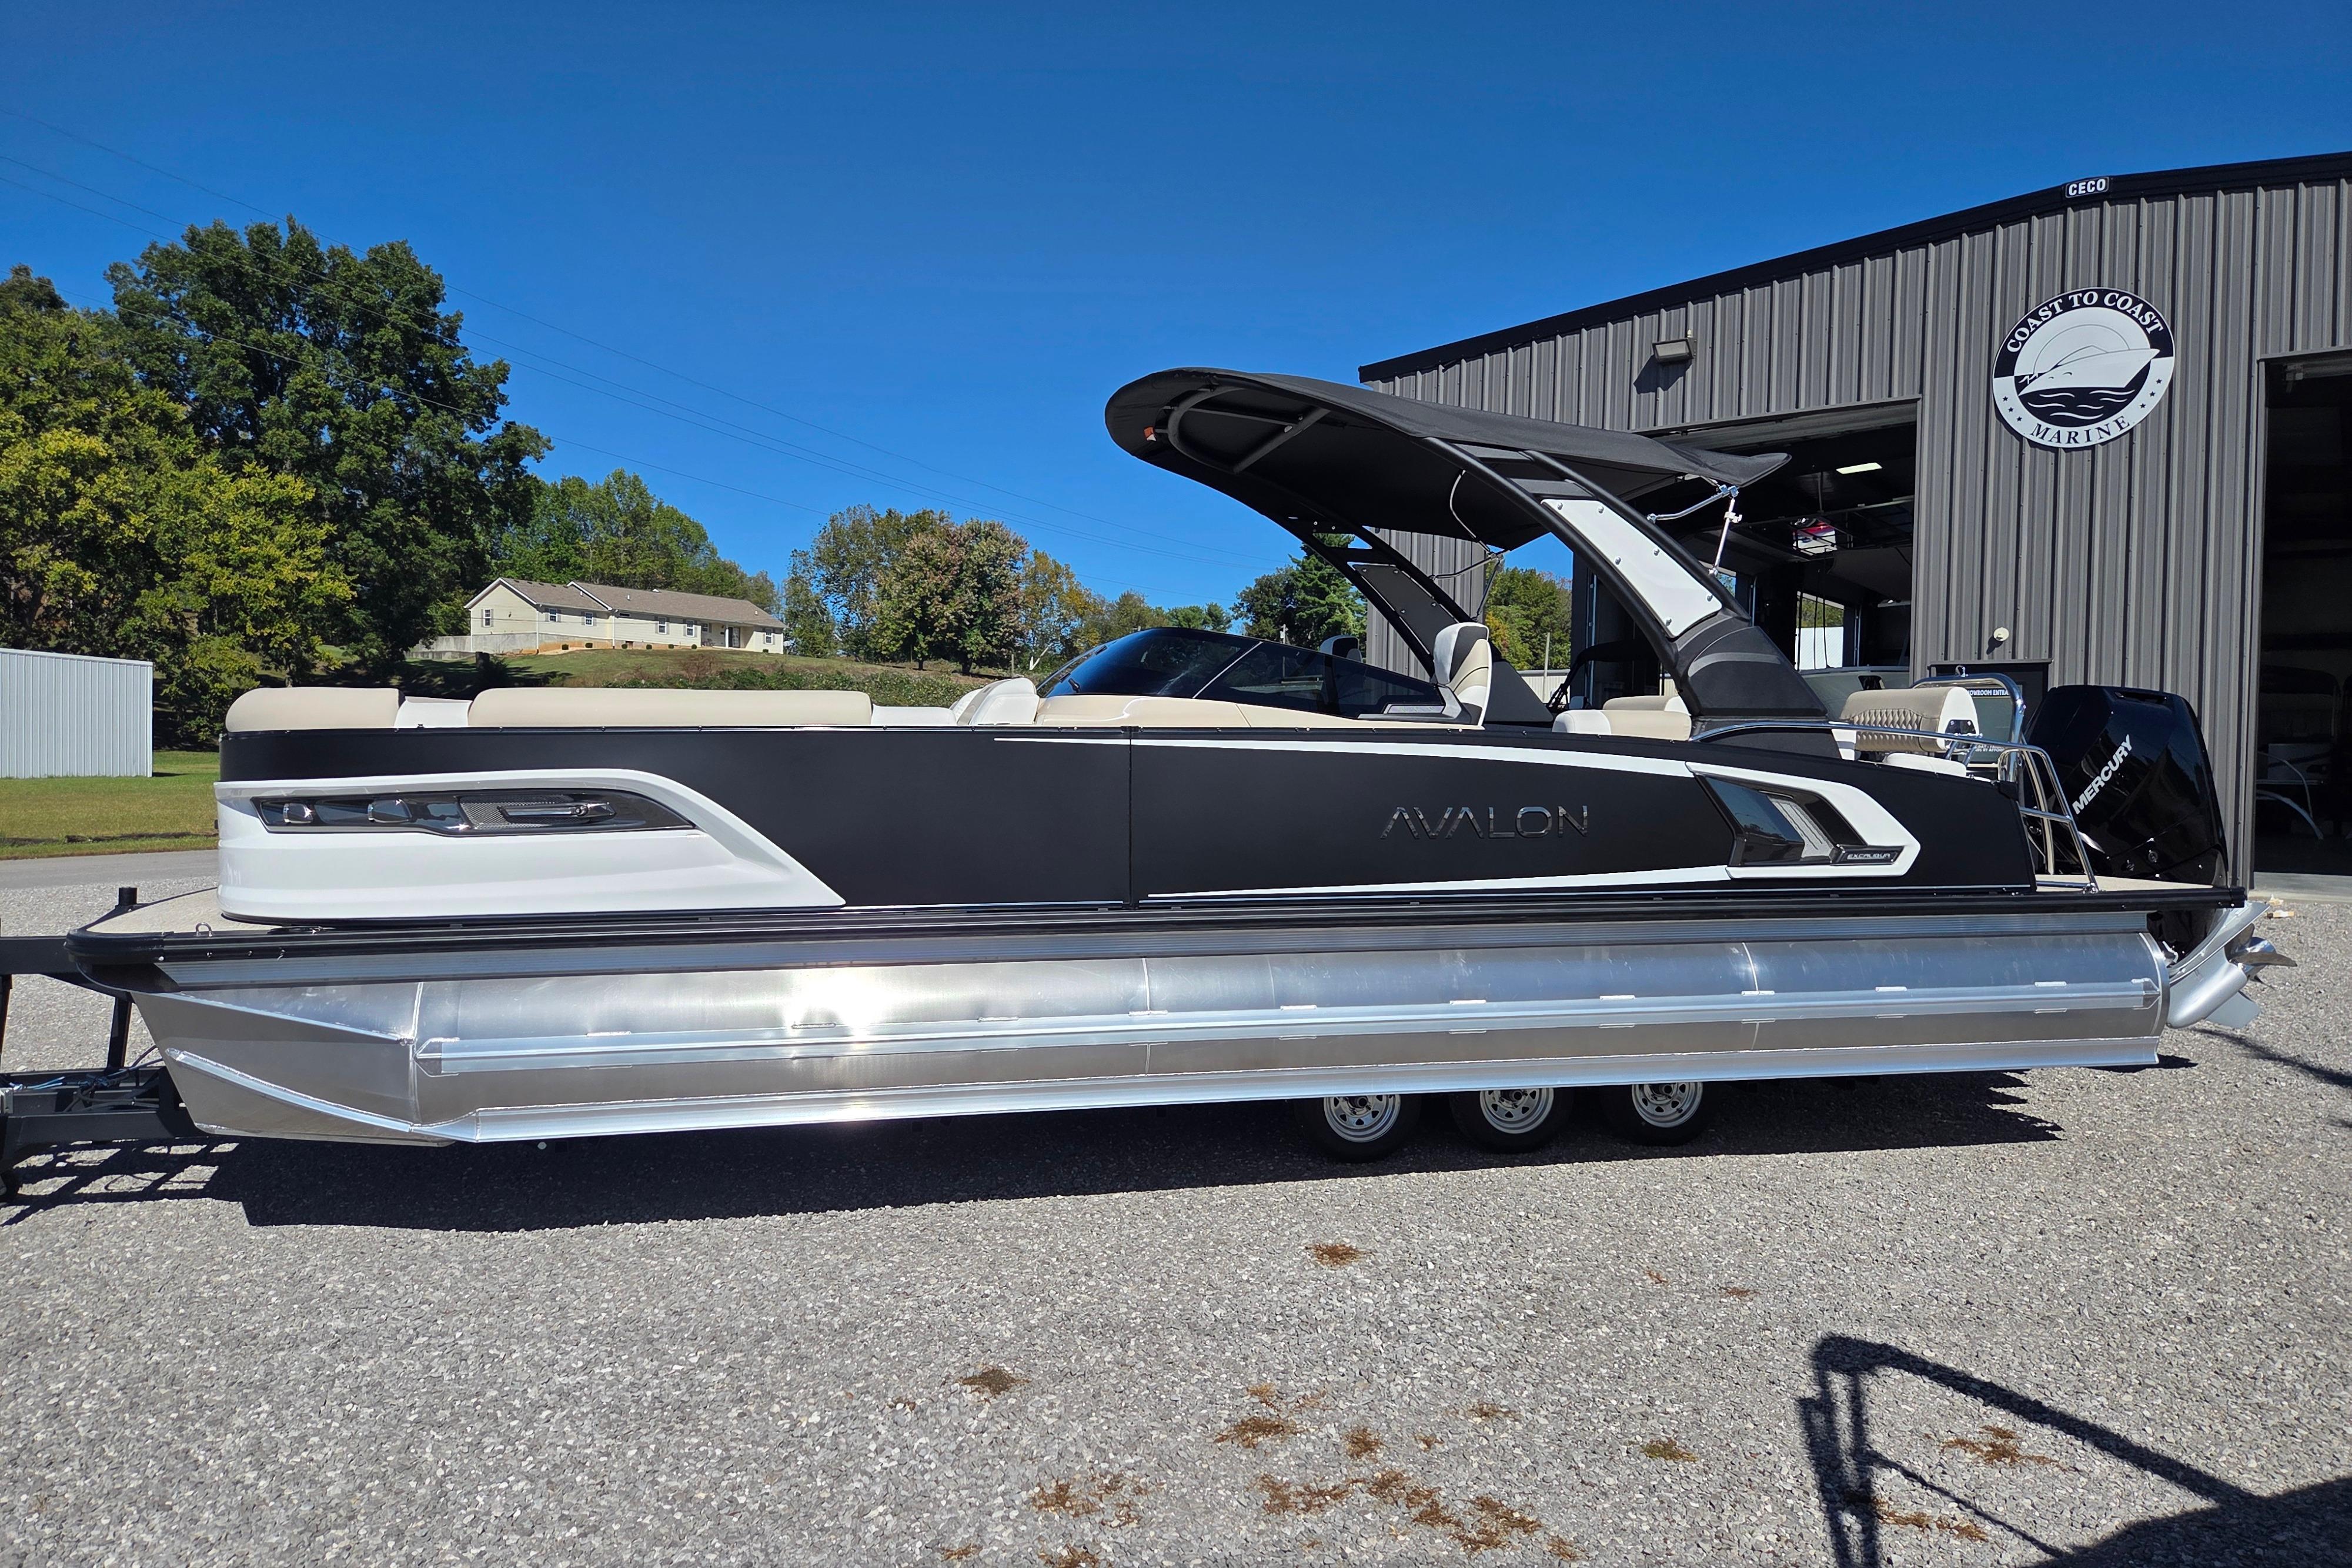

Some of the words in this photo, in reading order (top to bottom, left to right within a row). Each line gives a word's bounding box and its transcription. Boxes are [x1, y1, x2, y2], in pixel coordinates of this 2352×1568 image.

[2069, 179, 2106, 196] CECO
[2007, 299, 2063, 353] COAST
[2069, 291, 2098, 307] TO
[2103, 292, 2163, 334] COAST
[2030, 416, 2130, 444] MARINE
[2072, 734, 2132, 814] MERCURY
[1379, 806, 1588, 840] AVALON
